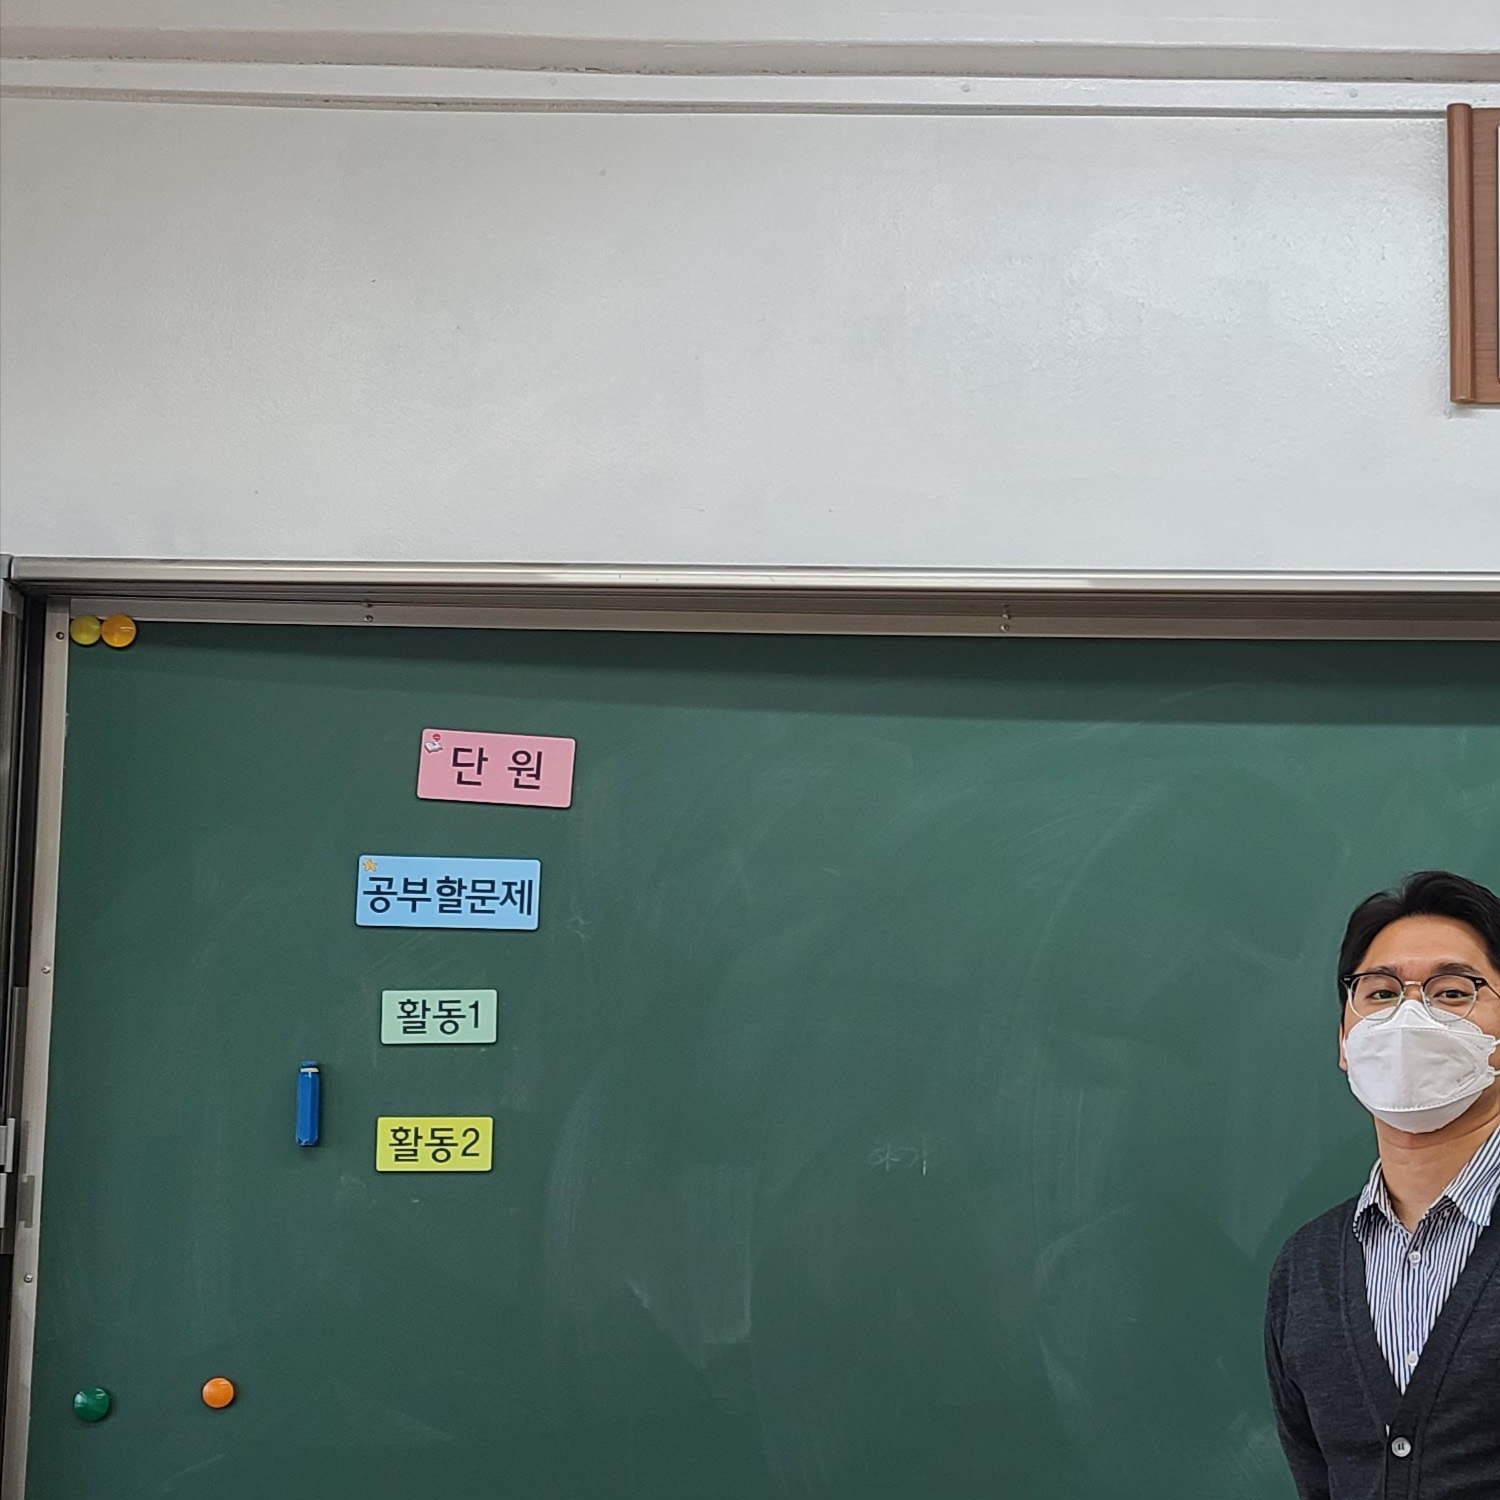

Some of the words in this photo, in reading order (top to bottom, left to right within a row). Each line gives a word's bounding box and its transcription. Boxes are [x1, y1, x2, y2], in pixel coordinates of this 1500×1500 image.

[362, 875, 533, 916] 공부할문제
[396, 998, 481, 1035] 활동1
[388, 1126, 481, 1164] 활동2
